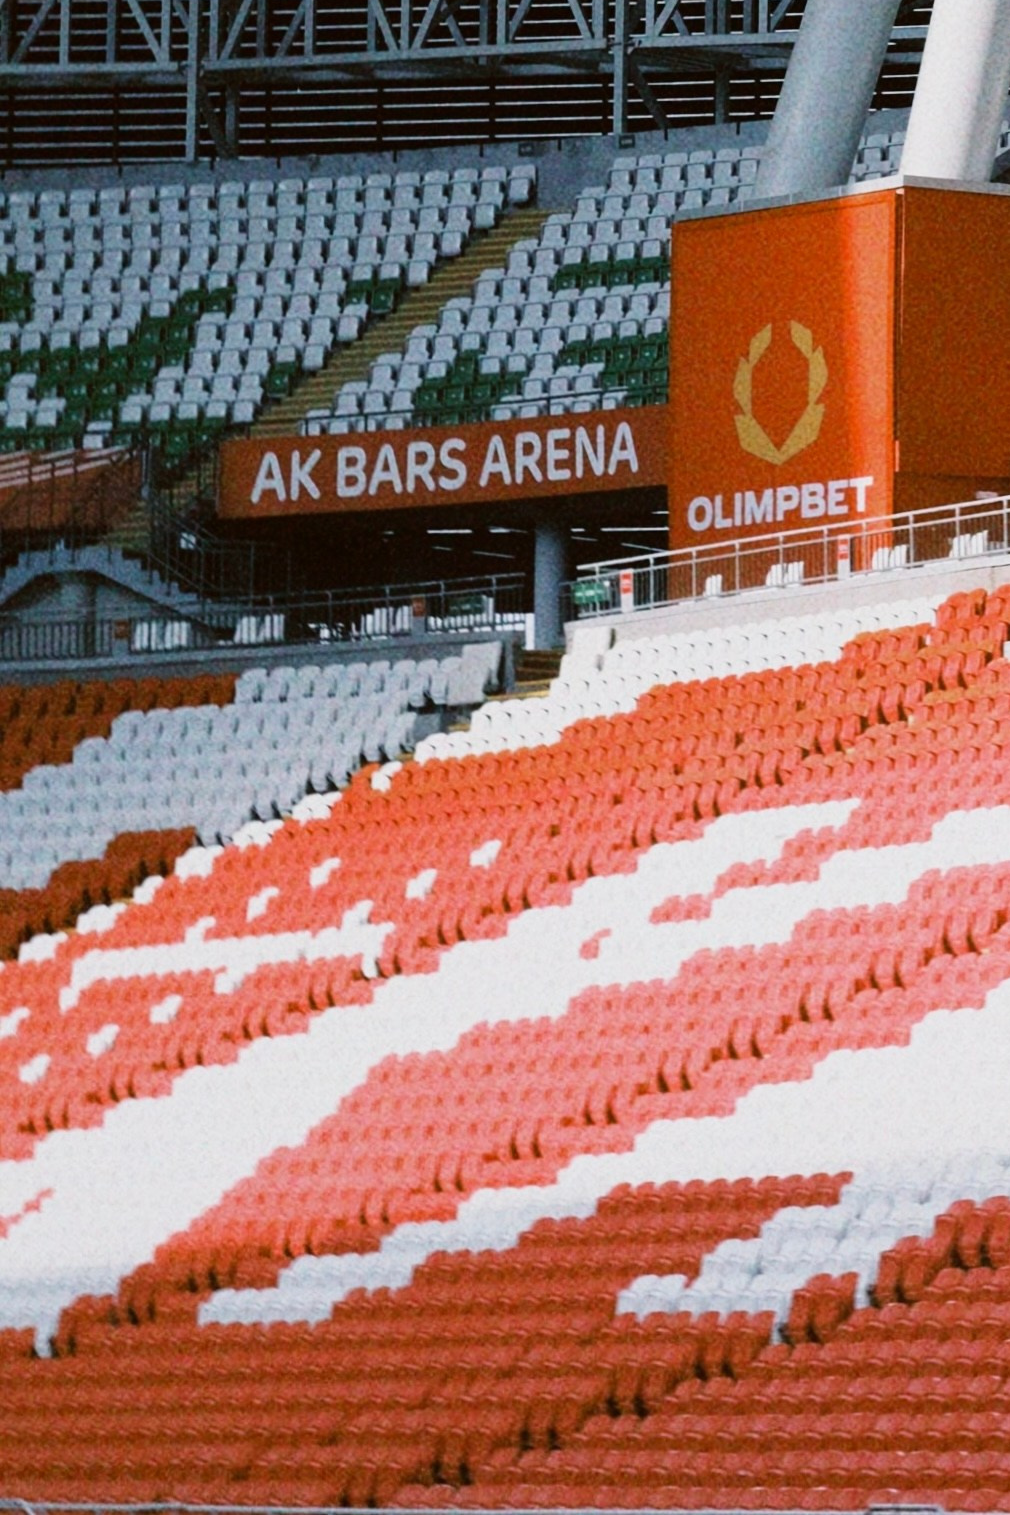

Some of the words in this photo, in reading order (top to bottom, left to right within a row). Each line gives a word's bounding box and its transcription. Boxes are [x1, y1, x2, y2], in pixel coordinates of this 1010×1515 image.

[250, 448, 322, 504] AK
[335, 437, 468, 498] BARS
[479, 421, 639, 487] ARENA
[686, 475, 874, 532] OLIMPBET
